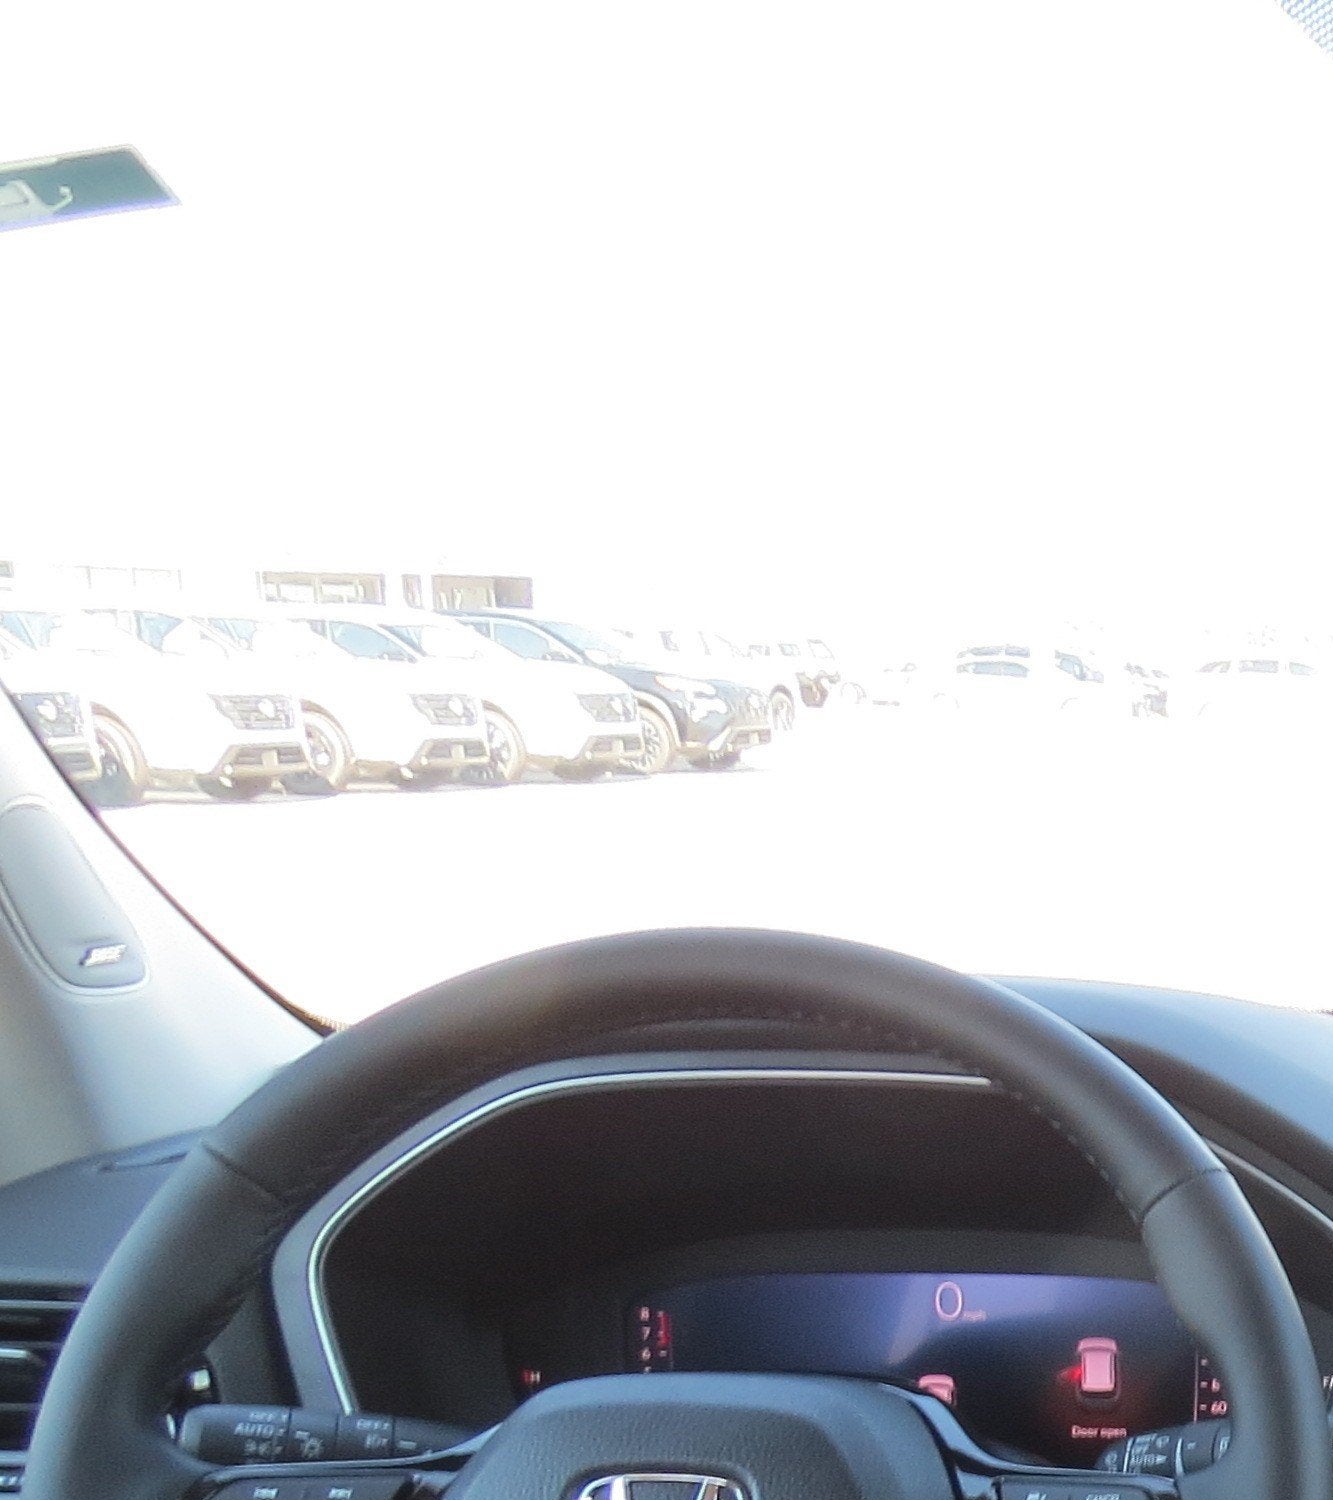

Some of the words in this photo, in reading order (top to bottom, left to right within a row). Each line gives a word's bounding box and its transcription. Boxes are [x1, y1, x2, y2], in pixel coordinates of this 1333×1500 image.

[935, 1279, 963, 1322] 0
[233, 1422, 275, 1438] AUTO
[1071, 1425, 1098, 1438] Door
[1100, 1427, 1127, 1440] open
